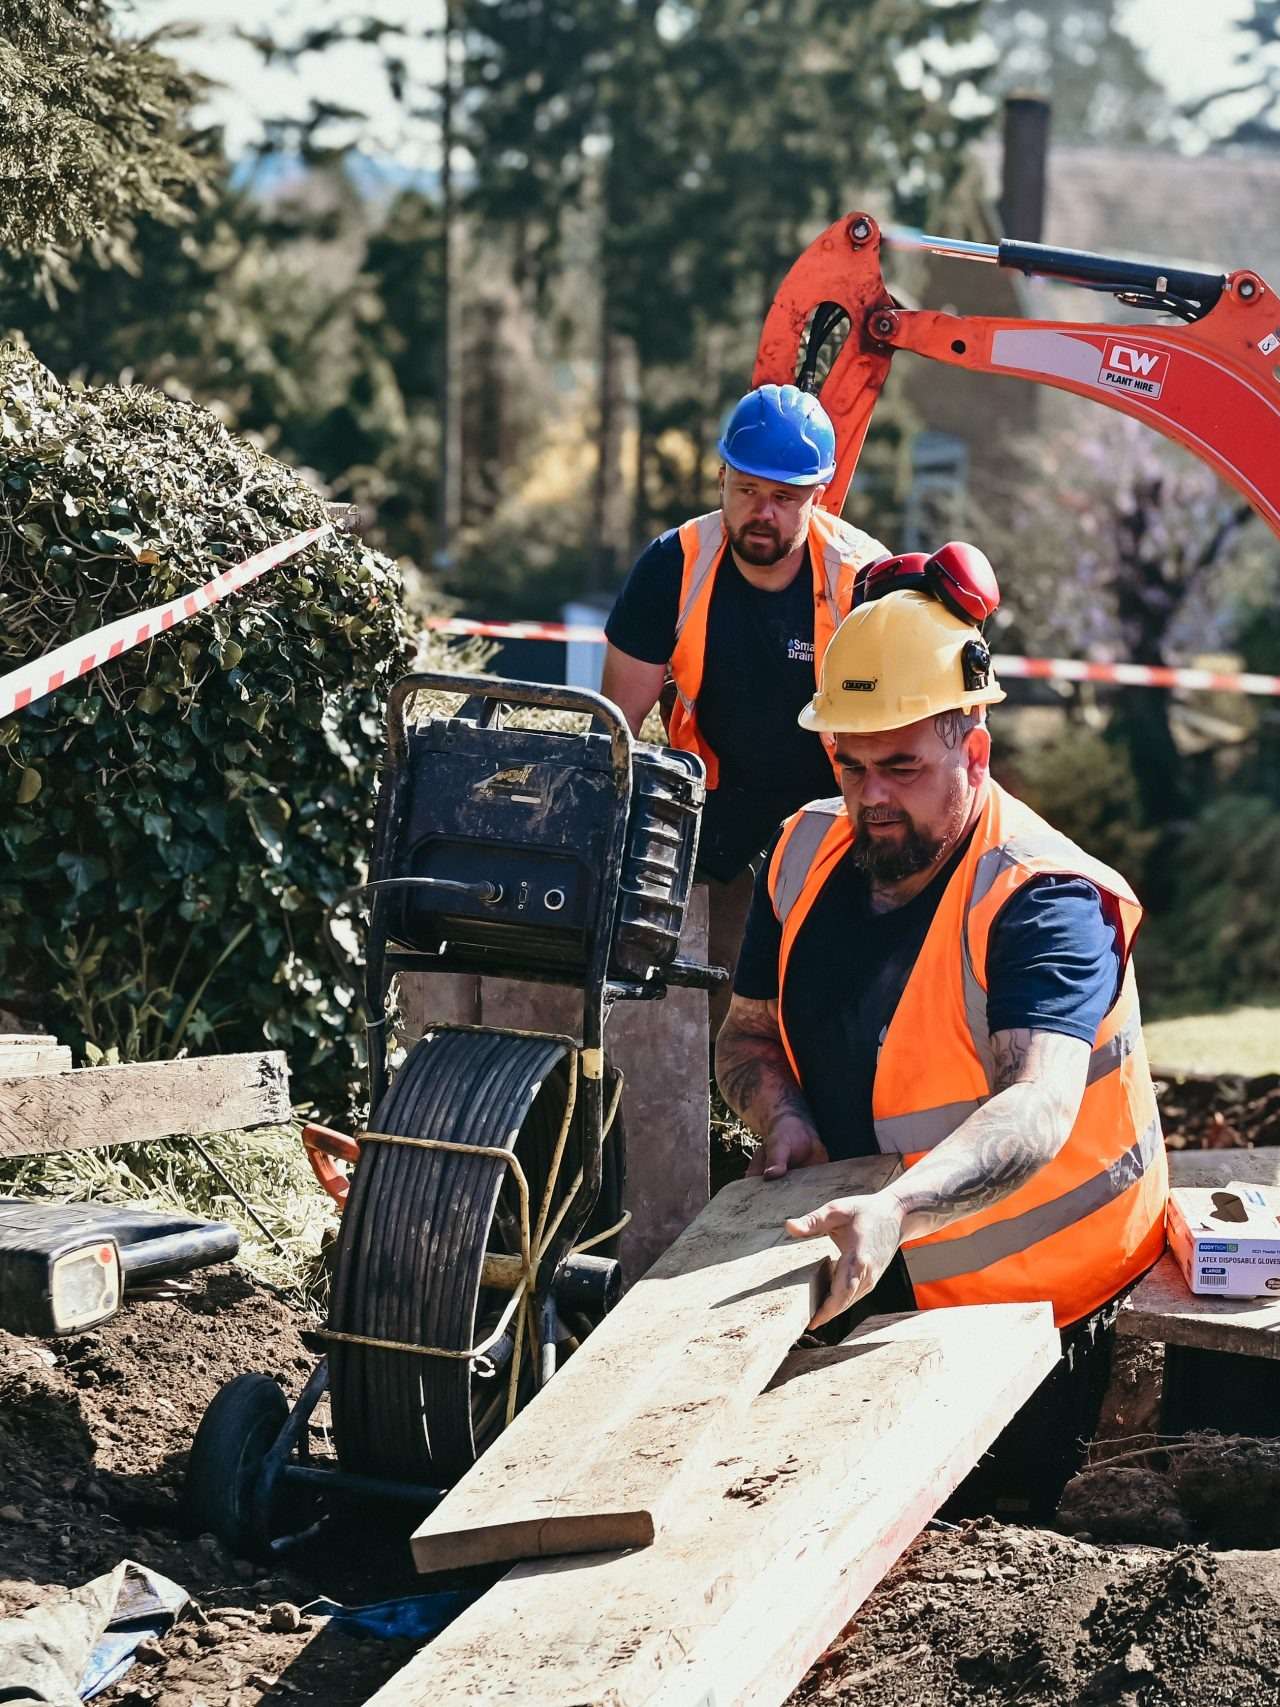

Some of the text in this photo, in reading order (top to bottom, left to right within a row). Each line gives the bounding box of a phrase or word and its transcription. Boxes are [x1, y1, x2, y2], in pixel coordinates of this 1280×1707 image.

[1109, 345, 1160, 376] CW
[1106, 373, 1154, 393] PLANT HIRE
